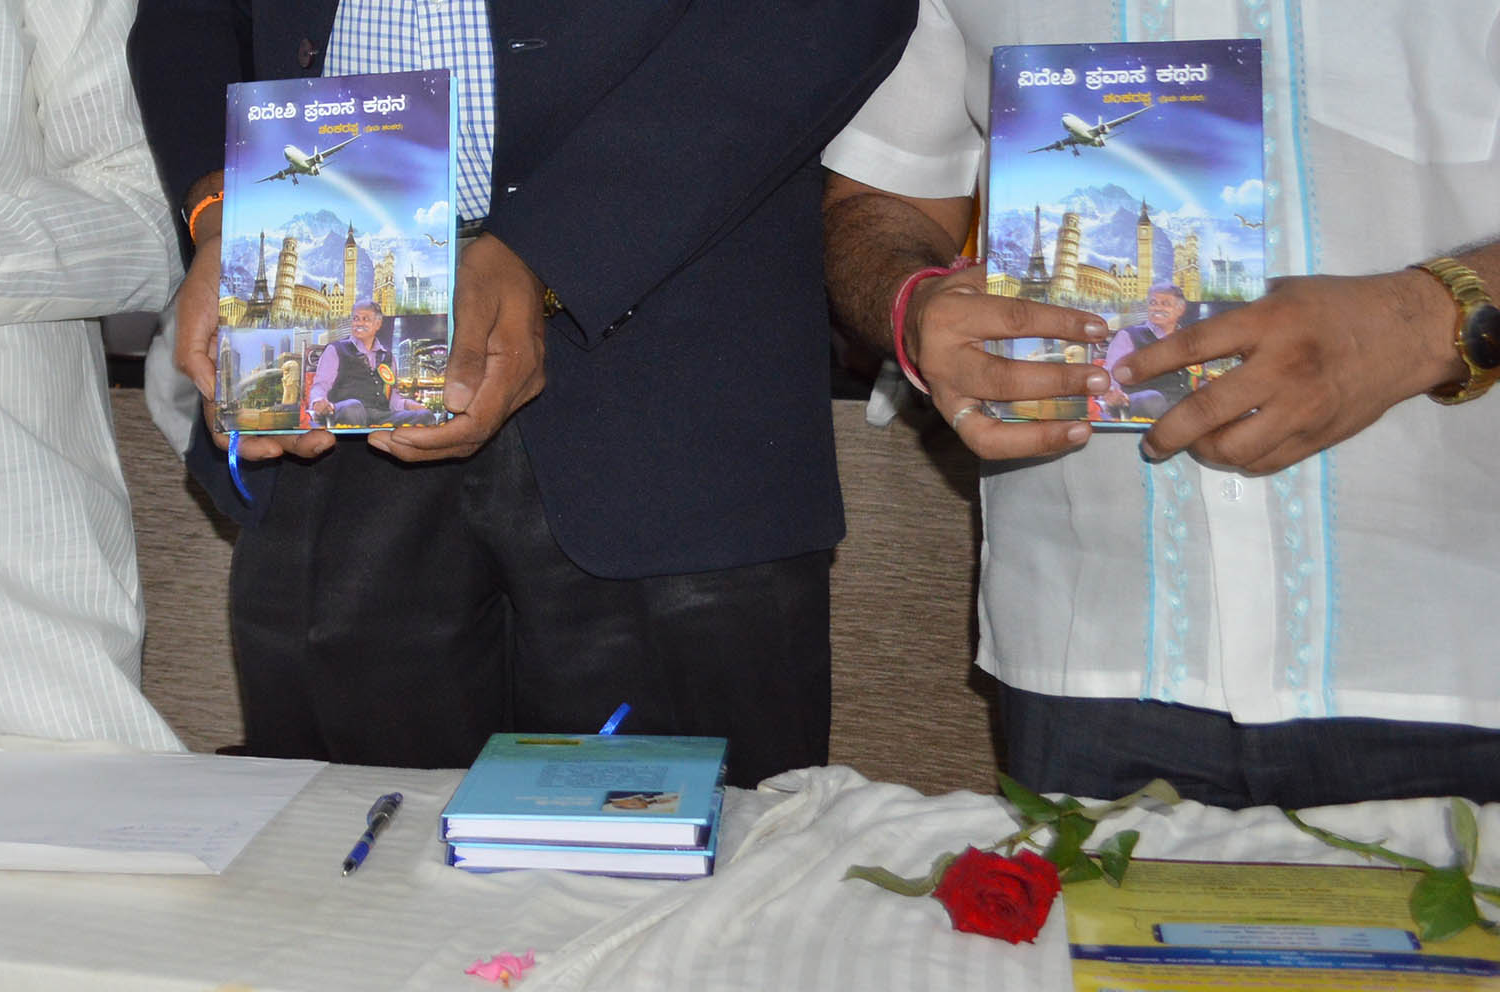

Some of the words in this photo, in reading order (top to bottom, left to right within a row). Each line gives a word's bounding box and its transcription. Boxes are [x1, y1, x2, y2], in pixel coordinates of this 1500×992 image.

[1017, 67, 1077, 88] ವಿದೇಶಿ
[1085, 64, 1148, 90] ಪ್ರವಾಸ
[1156, 63, 1210, 85] ಕಥನ
[247, 101, 297, 122] ವಿದೇಶಿ
[304, 97, 356, 122] ಪ್ರವಾಸ
[363, 93, 406, 116] ಕಥನ
